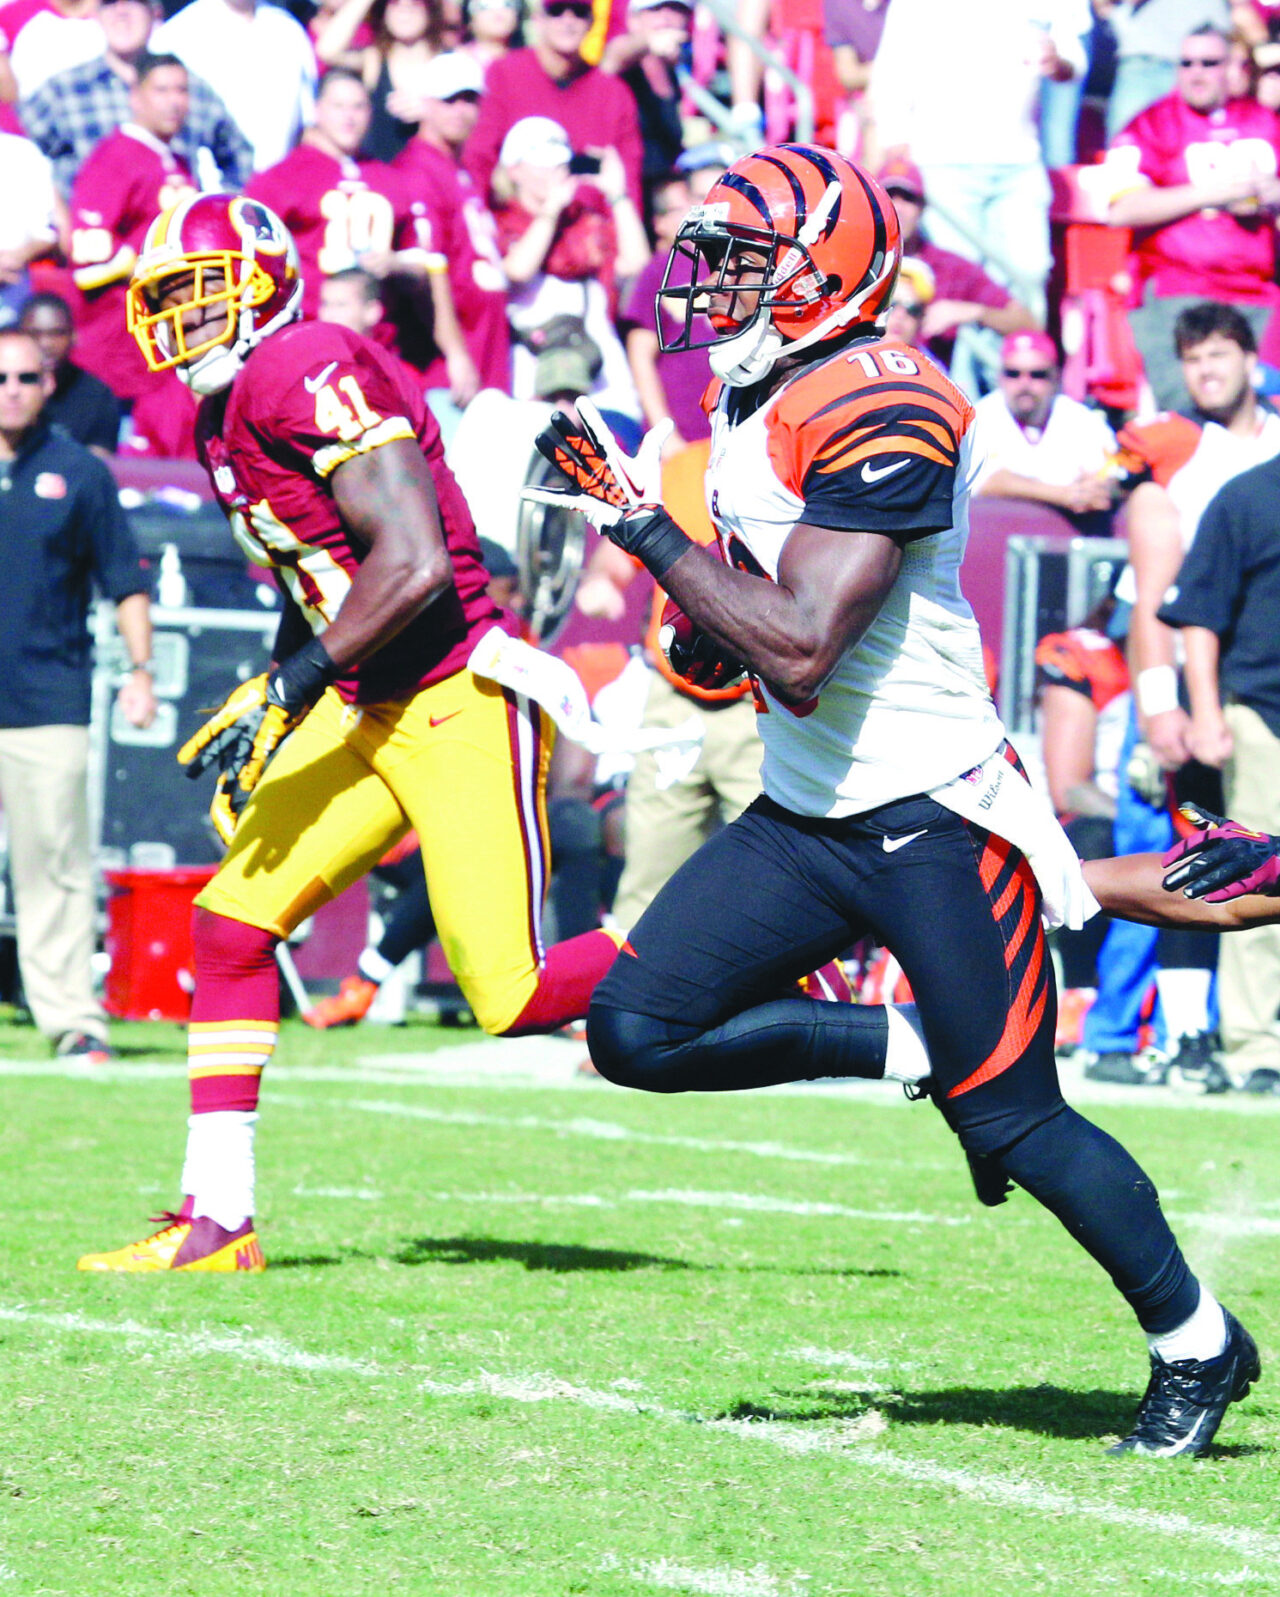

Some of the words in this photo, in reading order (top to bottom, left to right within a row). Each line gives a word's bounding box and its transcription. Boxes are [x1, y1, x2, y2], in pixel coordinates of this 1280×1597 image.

[847, 350, 920, 379] 16
[314, 374, 383, 442] 41
[978, 770, 1004, 811] Wilson
